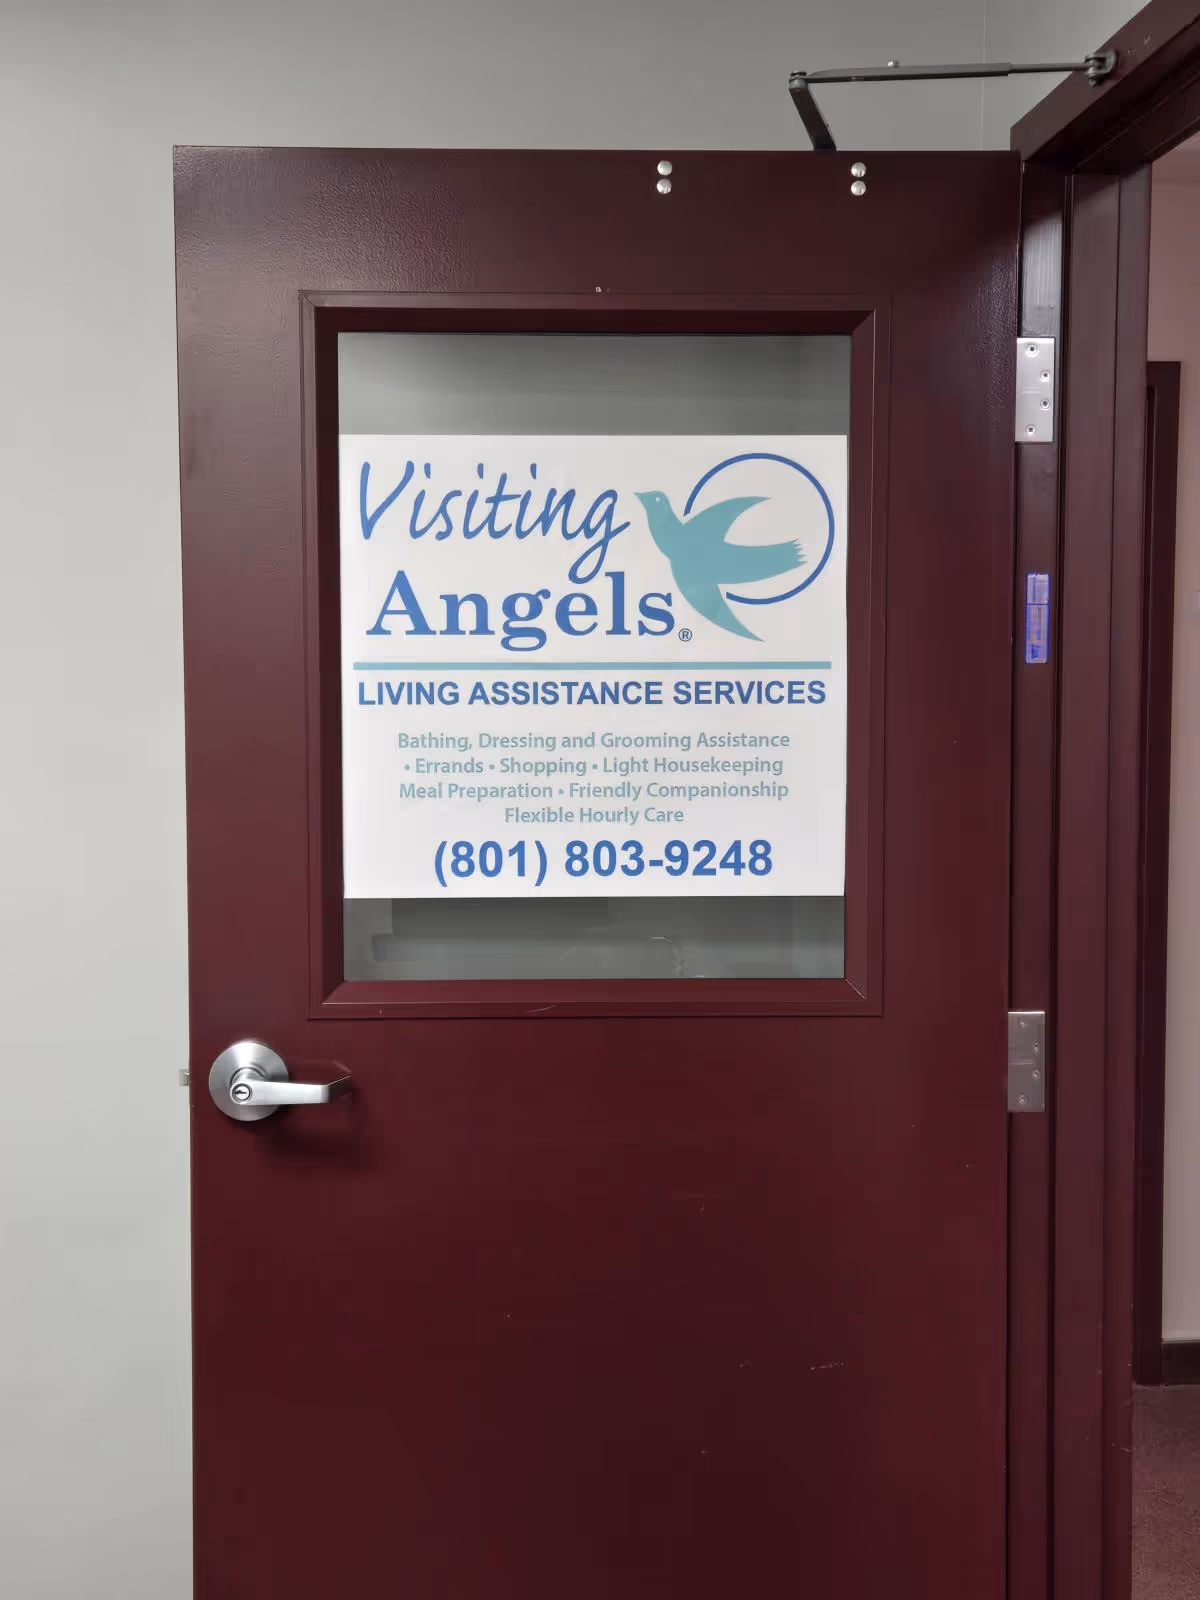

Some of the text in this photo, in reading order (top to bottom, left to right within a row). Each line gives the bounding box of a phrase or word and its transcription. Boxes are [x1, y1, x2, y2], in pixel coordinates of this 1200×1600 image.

[359, 460, 631, 584] Visiting
[357, 679, 827, 706] LIVING ASSISTANCE SERVICES
[397, 732, 791, 753] Bathing, Dressing and Grooming Assistance
[415, 757, 784, 777] Errands Shopping Light Housekeeping
[399, 781, 790, 802] Meal Preparation Friendly Companionship
[504, 807, 685, 827] Flexible Hourly Care
[434, 839, 774, 887] (801) 803-9248
